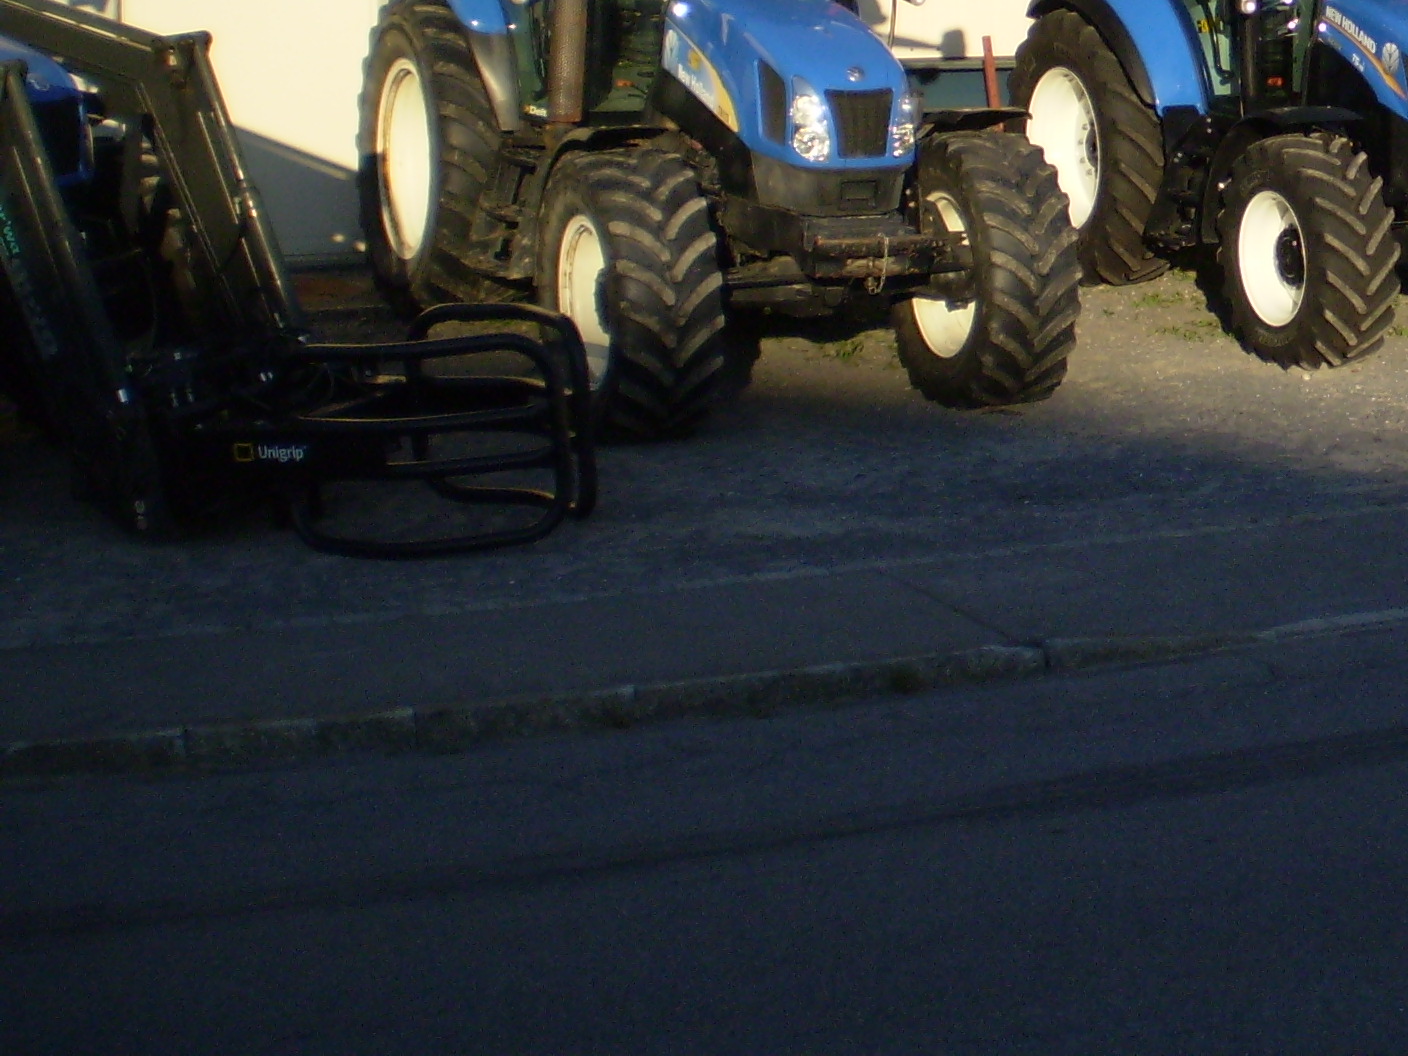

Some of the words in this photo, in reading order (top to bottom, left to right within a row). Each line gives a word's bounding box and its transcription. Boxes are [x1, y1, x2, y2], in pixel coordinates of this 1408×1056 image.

[1326, 5, 1342, 26] NEW
[1342, 15, 1376, 54] HOLLAND
[258, 444, 304, 462] Unigrip
